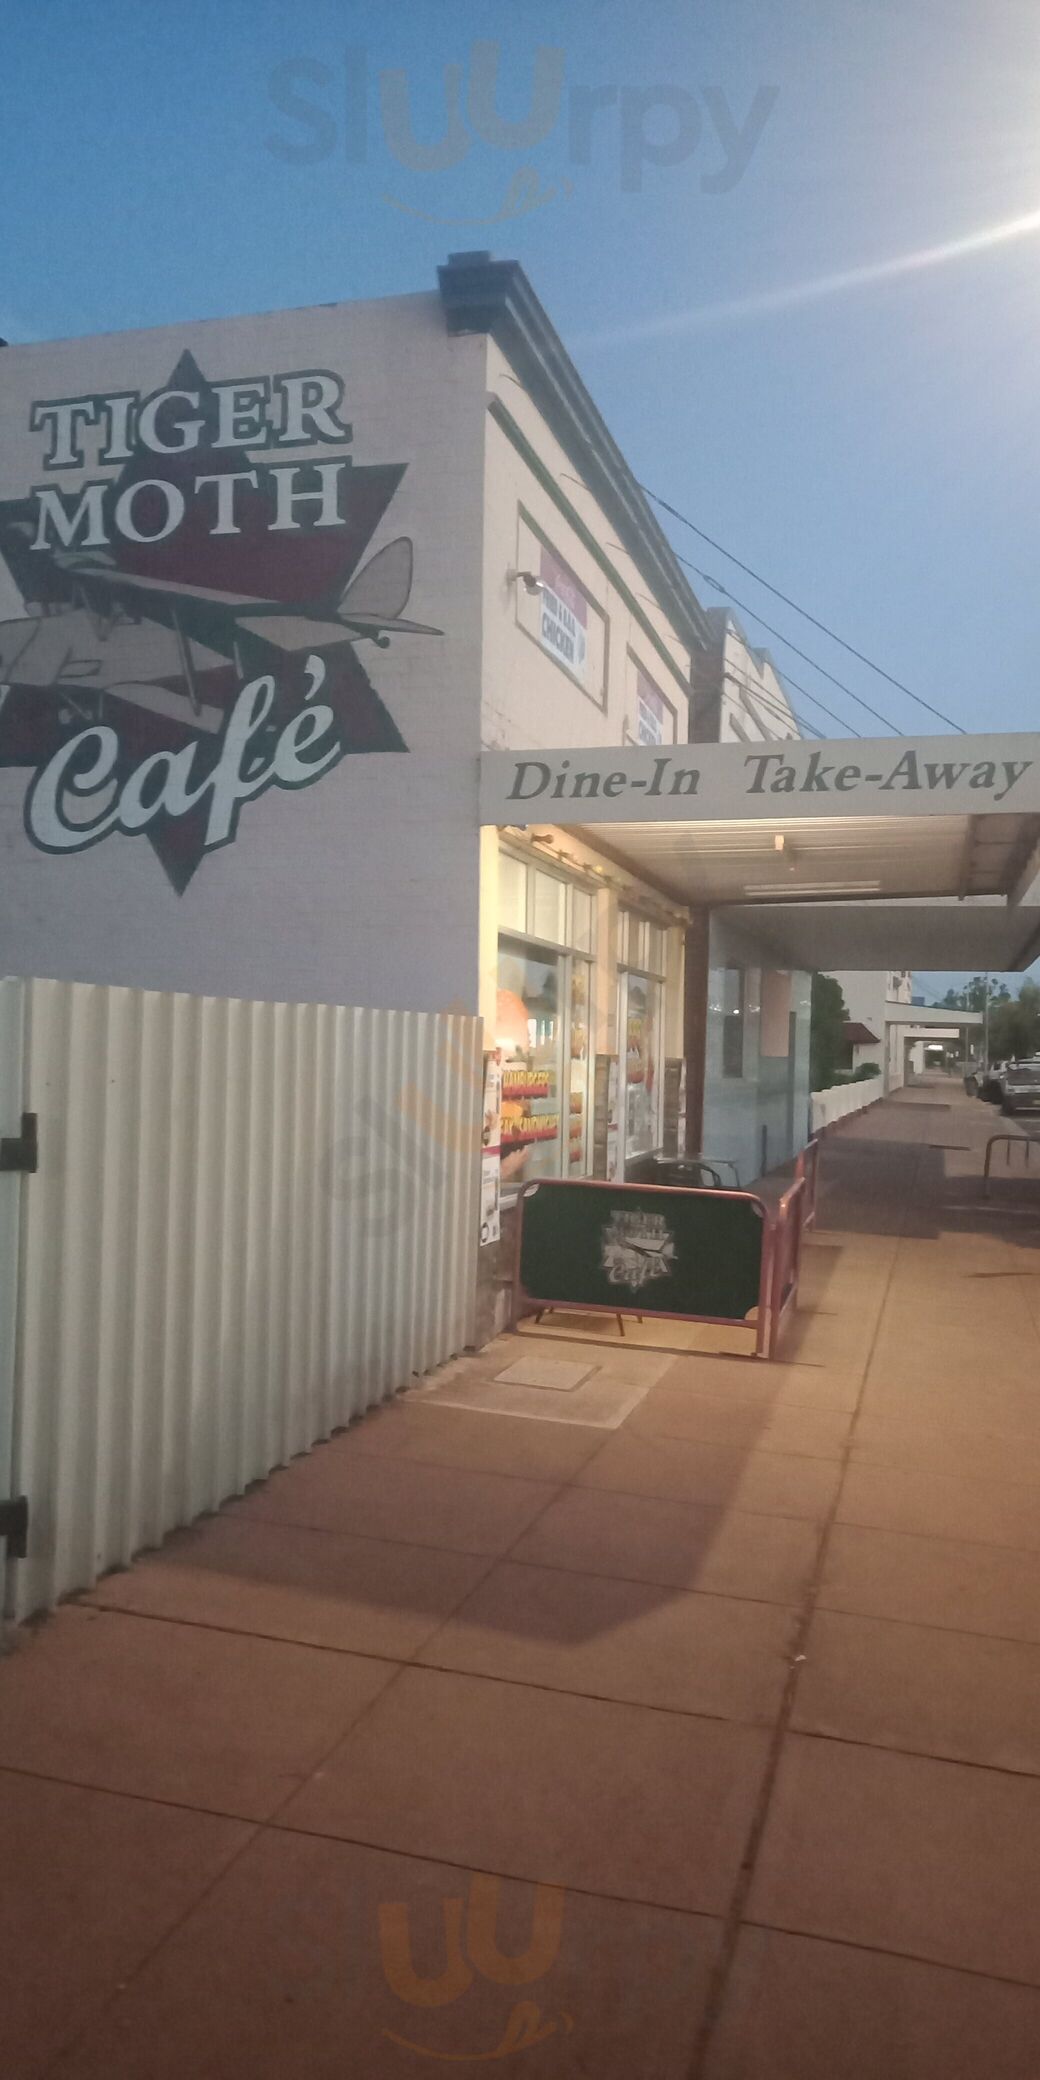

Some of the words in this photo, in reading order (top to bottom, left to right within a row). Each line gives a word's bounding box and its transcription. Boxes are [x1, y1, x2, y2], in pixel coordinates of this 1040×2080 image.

[35, 375, 346, 464] TIGER
[31, 461, 346, 551] MOTH
[30, 655, 341, 846] Café
[507, 758, 700, 801] Dine-In
[743, 750, 1033, 801] Take-Away
